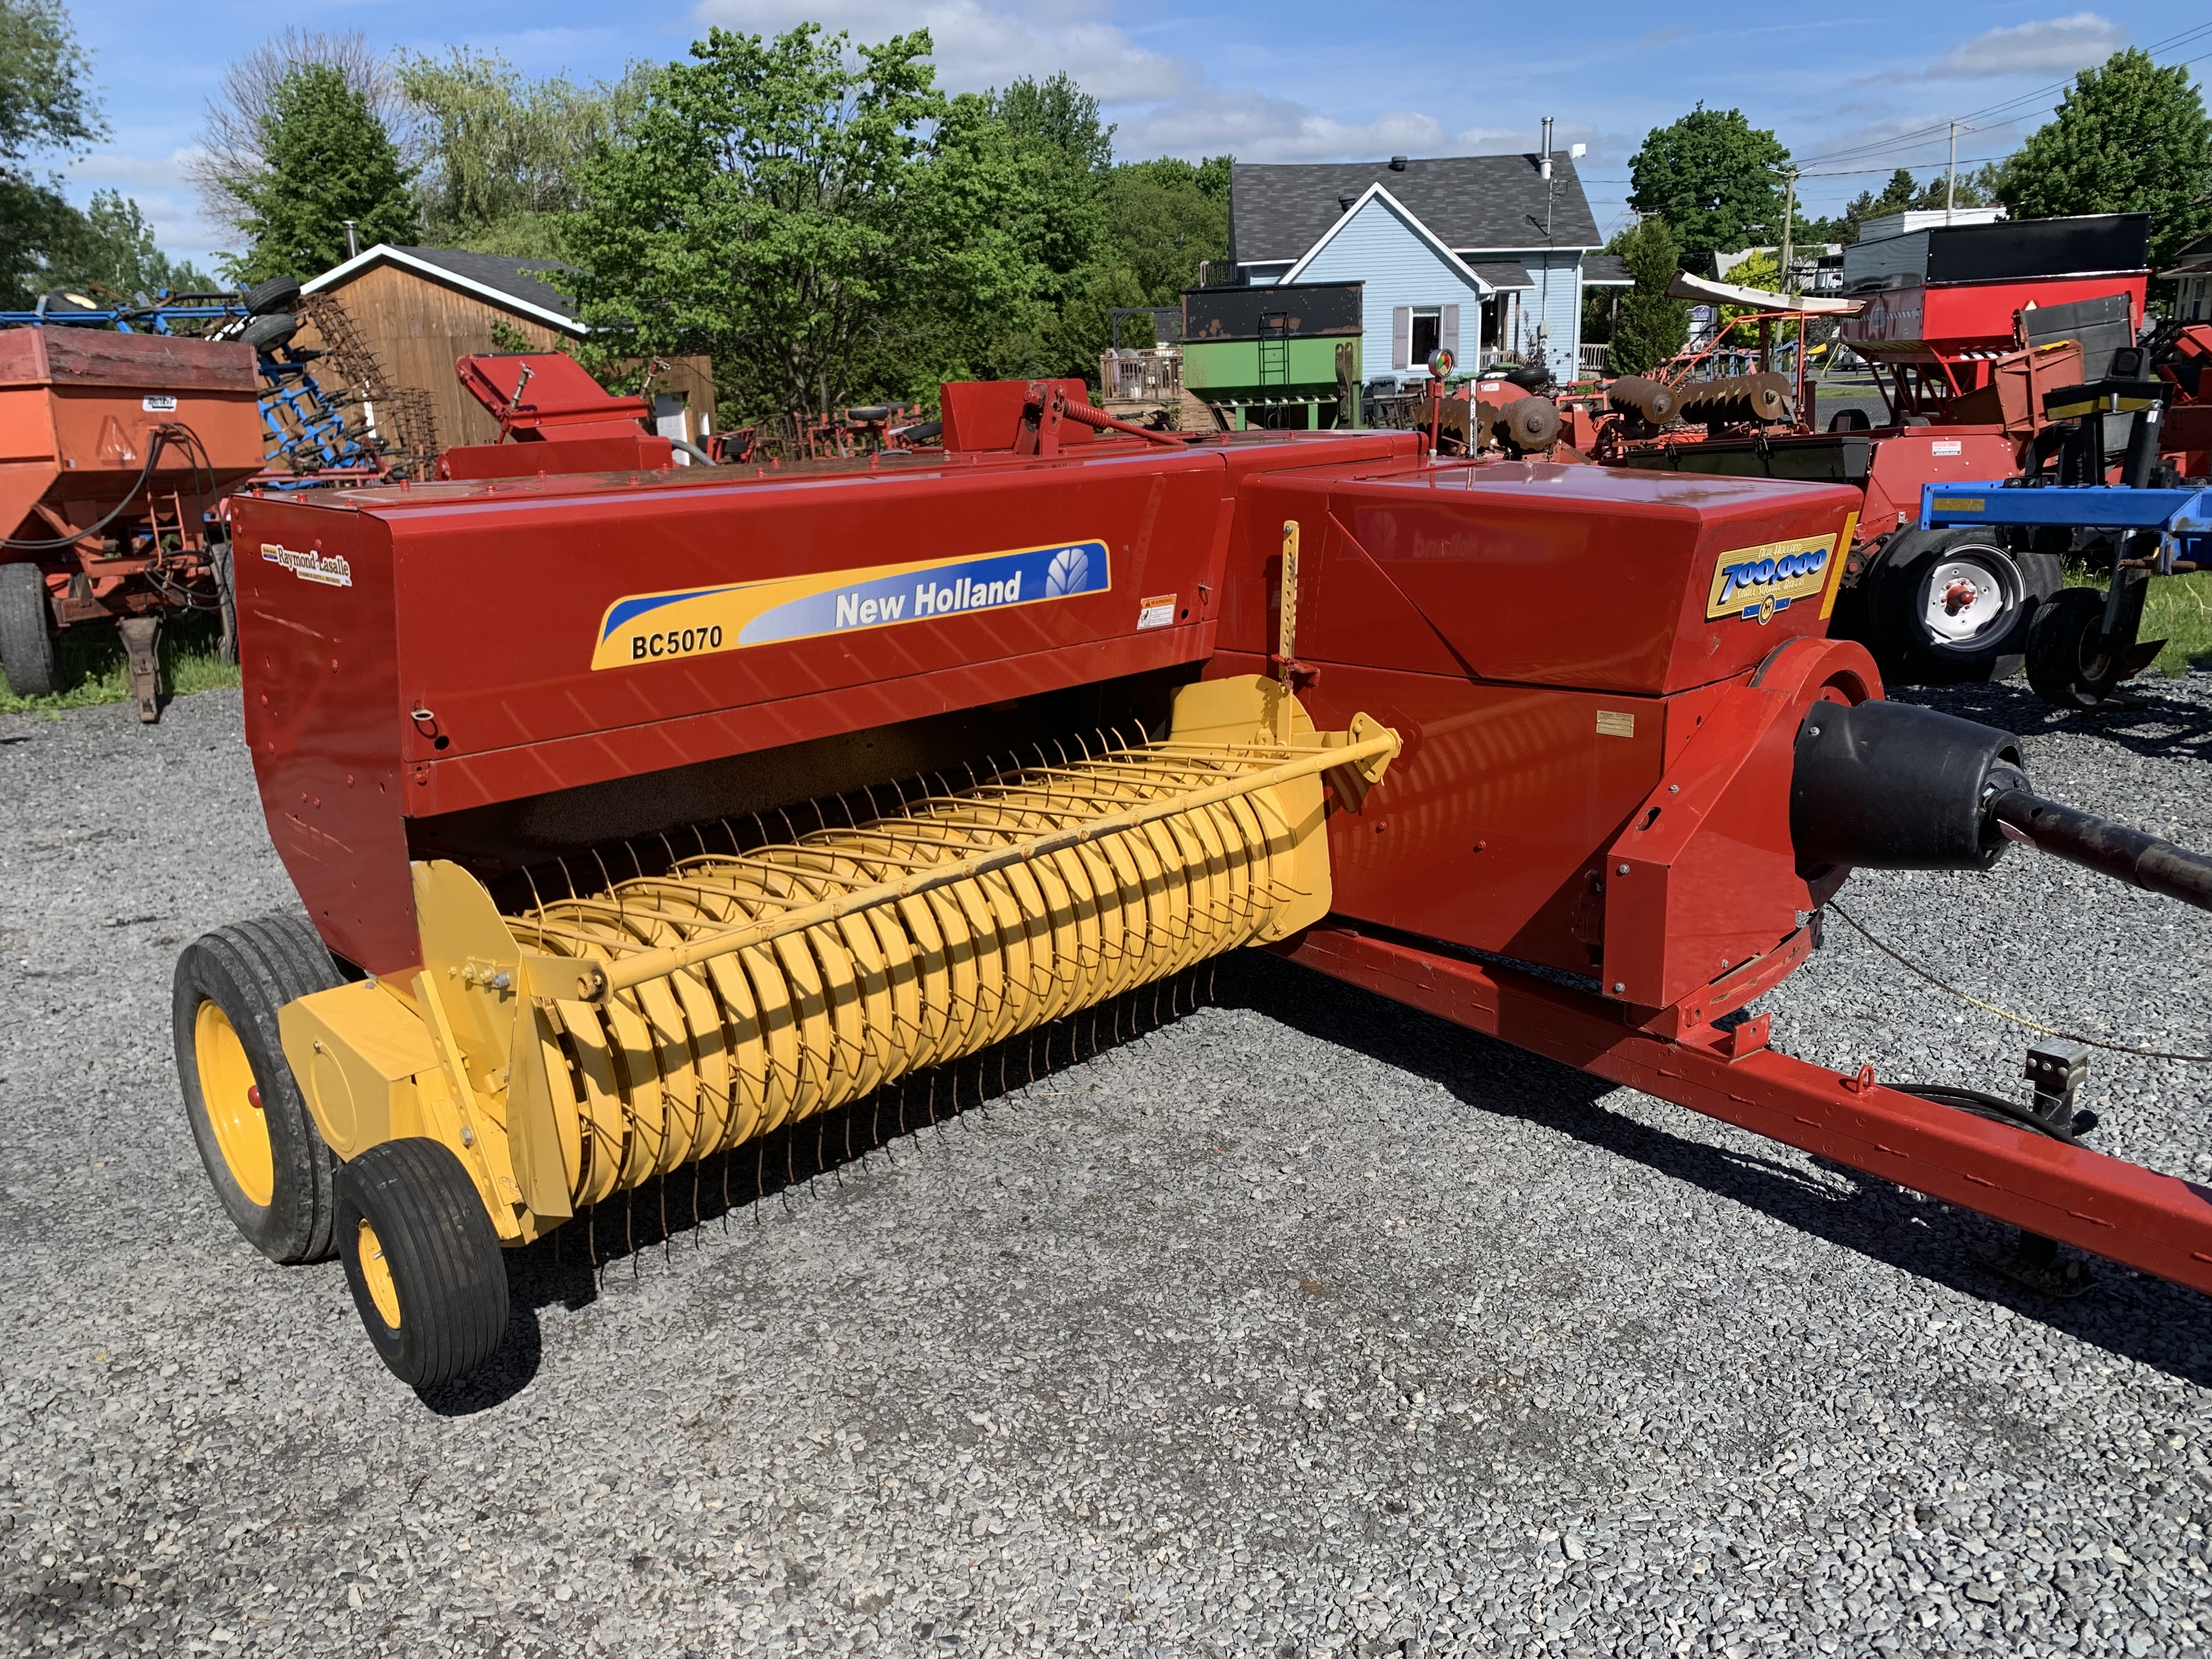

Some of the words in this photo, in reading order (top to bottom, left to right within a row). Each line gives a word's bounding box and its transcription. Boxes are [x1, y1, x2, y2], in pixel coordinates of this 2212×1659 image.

[278, 548, 317, 569] Raymond
[1758, 548, 1772, 558] NEW
[1773, 543, 1803, 555] HOLLAND
[1719, 549, 1827, 603] 700,000
[1737, 587, 1756, 600] SMALL
[1758, 582, 1782, 595] SQUARE
[1783, 577, 1805, 589] BALERS
[836, 592, 906, 628] New
[913, 571, 1022, 616] Holland
[633, 625, 723, 660] BC5070
